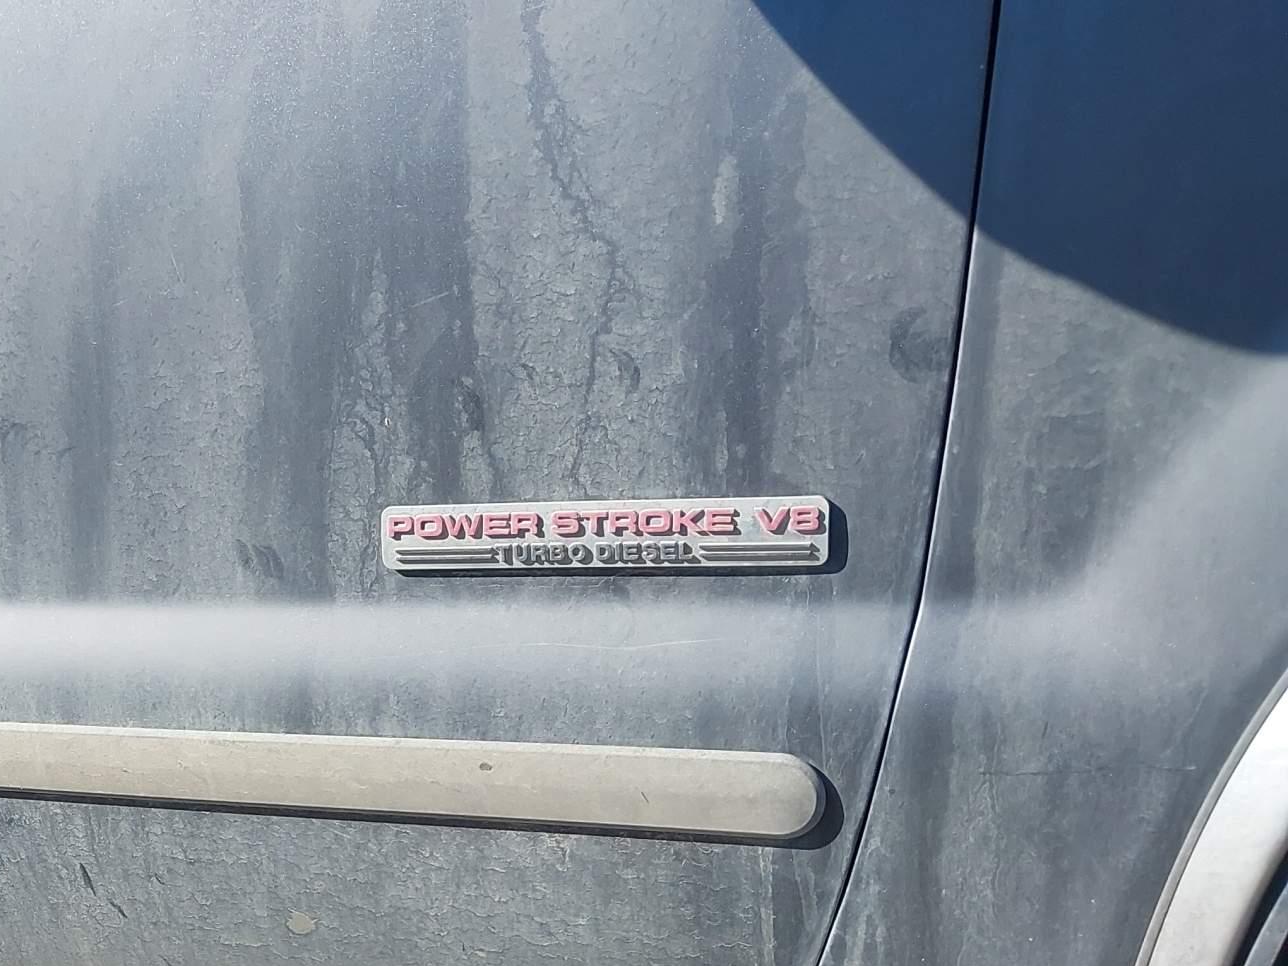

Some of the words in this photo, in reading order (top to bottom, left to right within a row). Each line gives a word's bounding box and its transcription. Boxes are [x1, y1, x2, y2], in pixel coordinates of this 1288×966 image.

[386, 512, 544, 541] POWER
[551, 508, 740, 537] STROKE
[754, 506, 826, 534] V8
[496, 543, 592, 565] TURBO
[599, 541, 701, 565] DIESEL
